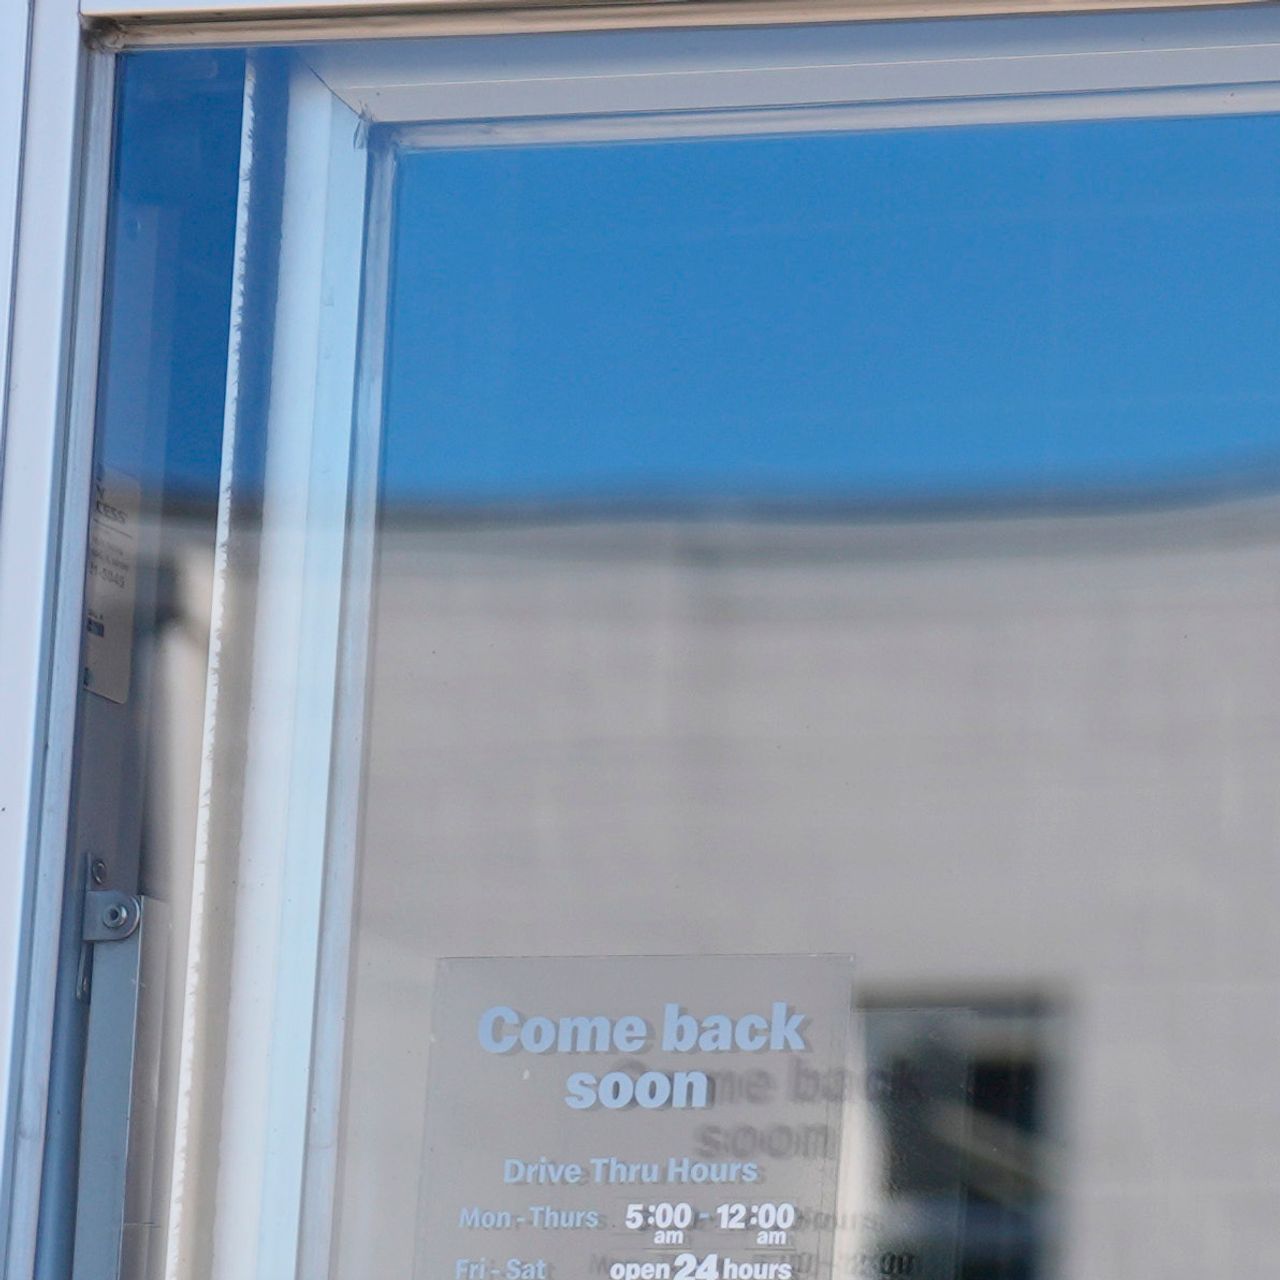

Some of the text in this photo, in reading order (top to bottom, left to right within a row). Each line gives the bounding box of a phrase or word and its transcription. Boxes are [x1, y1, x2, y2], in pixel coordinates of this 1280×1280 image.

[478, 1001, 806, 1053] Come back
[564, 1070, 708, 1109] soon
[503, 1156, 758, 1184] Drive Thru Hours
[625, 1203, 692, 1229] 5:00
[716, 1203, 795, 1229] 12:00
[654, 1230, 786, 1244] am am
[723, 1259, 792, 1280] hours
